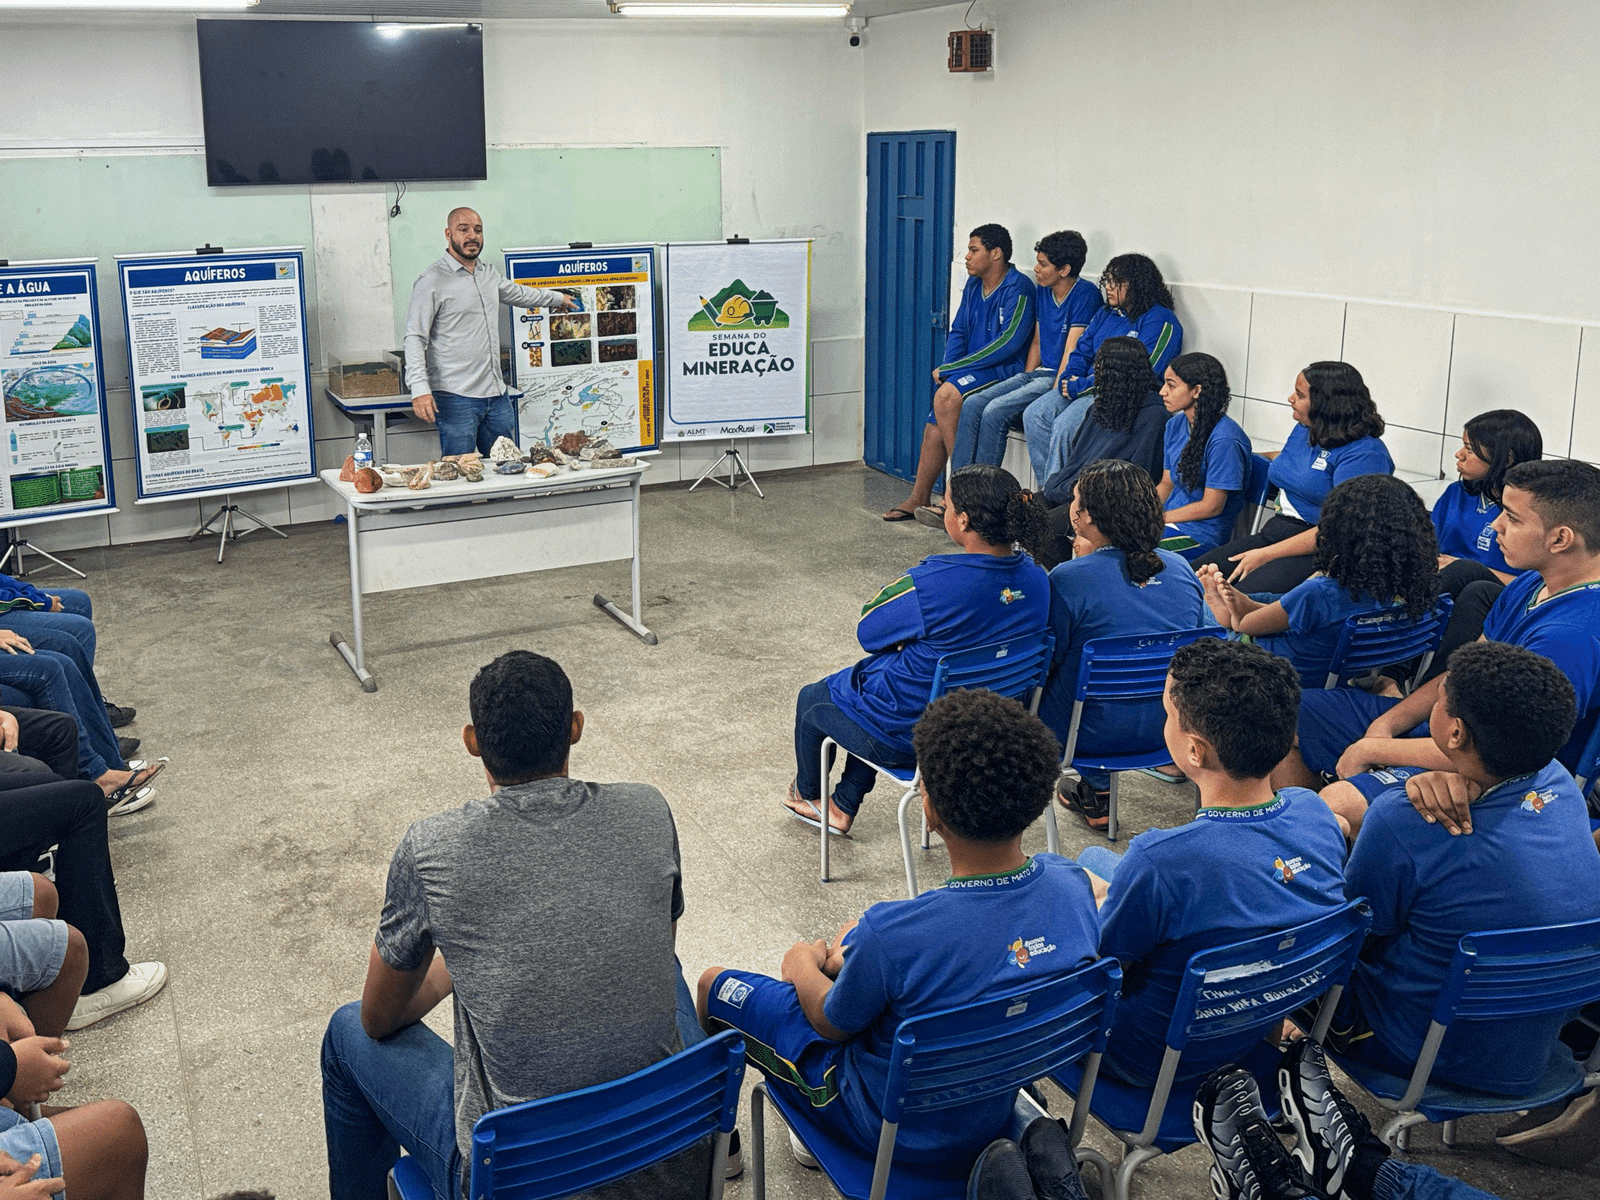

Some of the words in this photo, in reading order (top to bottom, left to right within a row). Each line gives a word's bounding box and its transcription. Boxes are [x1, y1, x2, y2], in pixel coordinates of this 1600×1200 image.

[184, 266, 246, 282] AQUÍFEROS
[558, 260, 608, 274] AQUÍFEROS
[6, 283, 15, 294] A
[18, 279, 51, 294] ÁGUA
[709, 340, 770, 357] EDUCA
[683, 354, 794, 377] MINERAÇÃO
[1208, 810, 1251, 818] GOVERNO
[1253, 809, 1264, 817] DE
[1265, 802, 1281, 814] MATO
[950, 878, 994, 889] GOVERNO
[996, 877, 1010, 886] DE
[1011, 868, 1031, 882] MATO
[1029, 944, 1057, 957] educação
